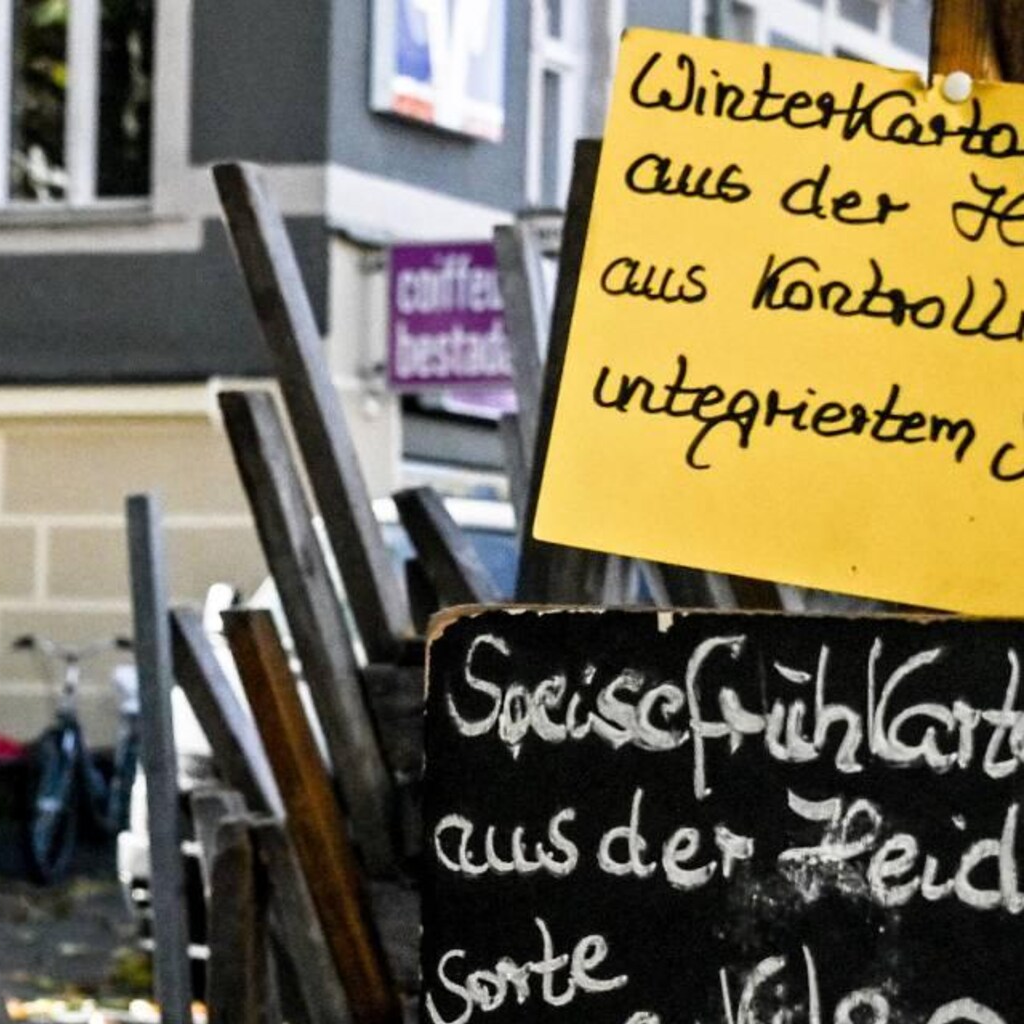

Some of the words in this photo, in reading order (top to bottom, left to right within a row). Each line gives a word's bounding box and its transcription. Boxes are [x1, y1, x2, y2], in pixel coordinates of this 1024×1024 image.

[624, 152, 752, 201] aus
[780, 164, 911, 225] der
[599, 256, 708, 304] aus
[433, 808, 578, 877] aus
[596, 787, 755, 889] der
